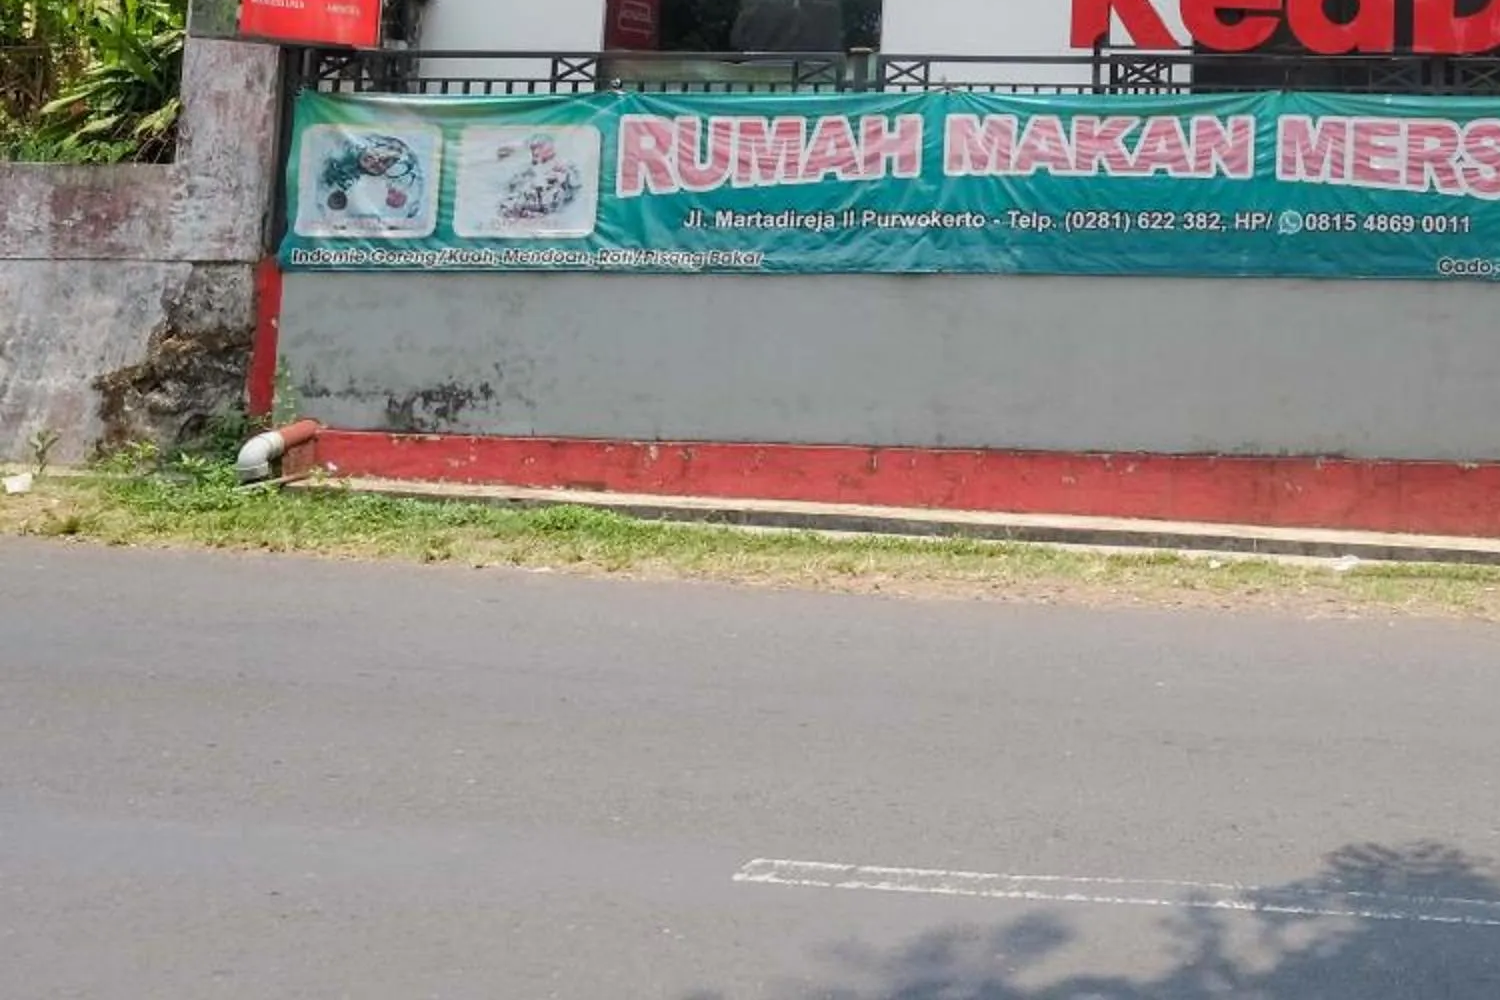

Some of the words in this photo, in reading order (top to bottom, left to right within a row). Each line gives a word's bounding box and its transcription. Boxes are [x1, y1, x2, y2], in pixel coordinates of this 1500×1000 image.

[616, 114, 924, 197] RUMAH
[944, 113, 1256, 179] MAKAN
[714, 209, 836, 233] Martadireja
[861, 210, 986, 229] Purwokerto
[1006, 210, 1058, 230] Telp.
[1064, 211, 1131, 234] (0281)
[1137, 212, 1175, 230] 622
[1183, 212, 1227, 233] 382,
[1304, 213, 1358, 232] 0815
[1363, 214, 1415, 232] 4869
[1421, 215, 1471, 233] 0011
[292, 247, 367, 264] Indomie
[708, 250, 764, 267] Bakar
